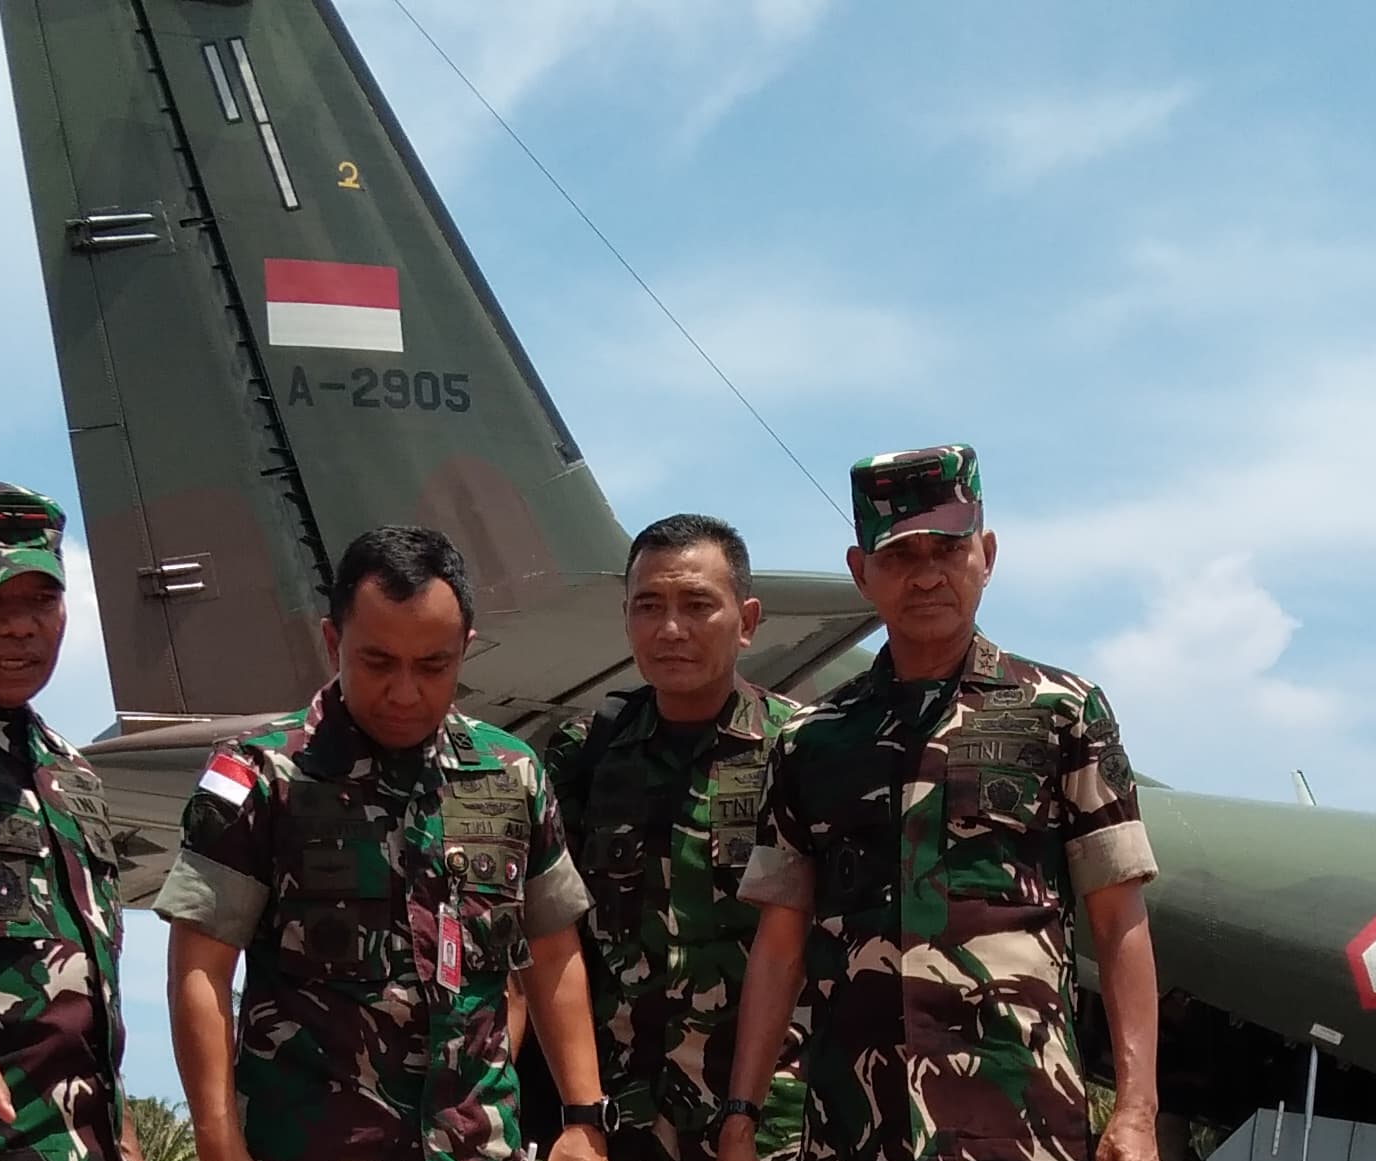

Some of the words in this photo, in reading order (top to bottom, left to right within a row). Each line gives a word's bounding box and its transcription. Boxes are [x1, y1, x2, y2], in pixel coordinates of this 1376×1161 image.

[336, 161, 361, 189] 2
[287, 364, 471, 413] A-2905
[957, 741, 1003, 761] TNI
[67, 796, 99, 815] TNI
[718, 797, 754, 818] TNI
[459, 820, 494, 835] TNI
